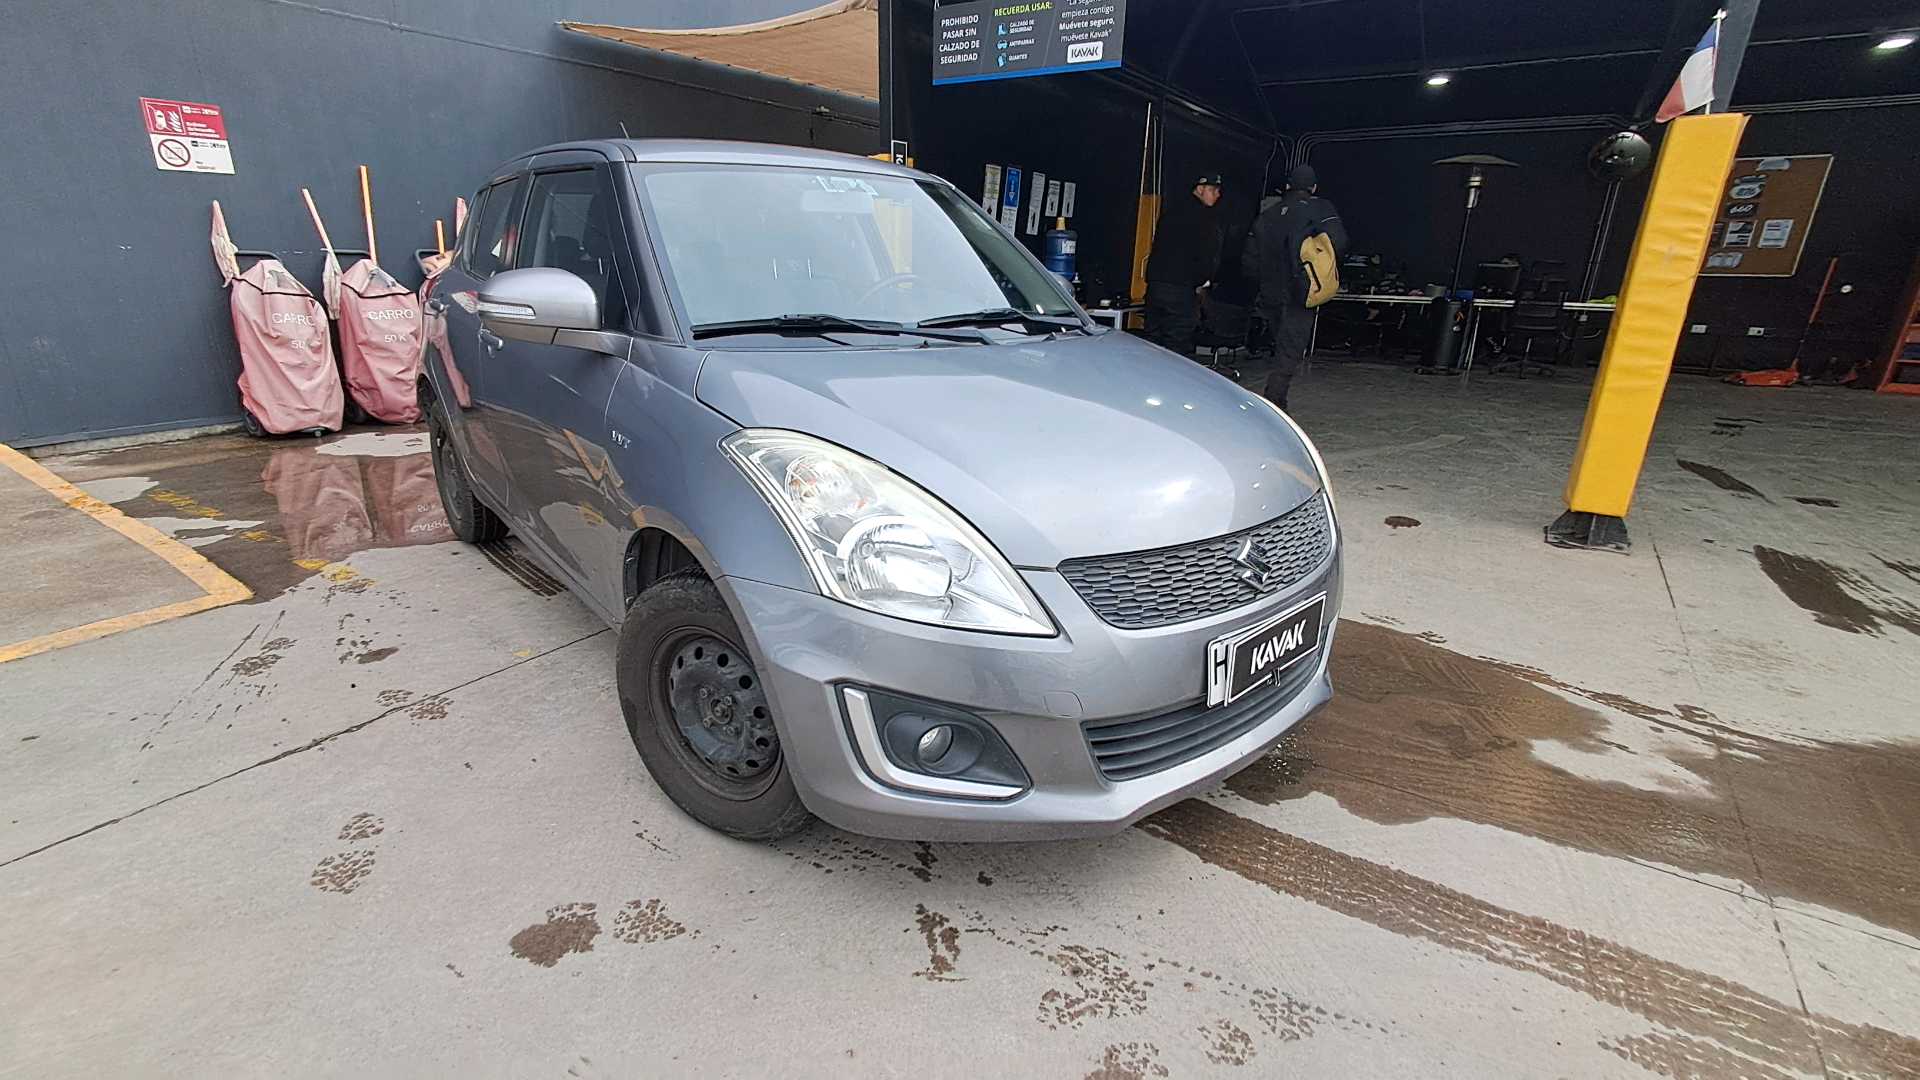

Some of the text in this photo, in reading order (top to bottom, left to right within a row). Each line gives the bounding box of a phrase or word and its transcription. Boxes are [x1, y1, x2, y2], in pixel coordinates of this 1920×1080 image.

[994, 1, 1053, 16] RECUERDA USAR:
[1061, 5, 1114, 19] empieza contigo
[941, 14, 979, 27] PROHIBIDO
[1059, 20, 1089, 30] Muévete
[942, 28, 977, 40] PASAR SIN
[1060, 32, 1089, 42] muévete
[939, 40, 980, 52] CALZADO DE
[1071, 46, 1099, 58] KAVAK
[940, 53, 978, 65] SEGURIDAD
[367, 309, 414, 321] CARRO
[384, 334, 397, 343] 50
[1250, 619, 1306, 674] KAVAK
